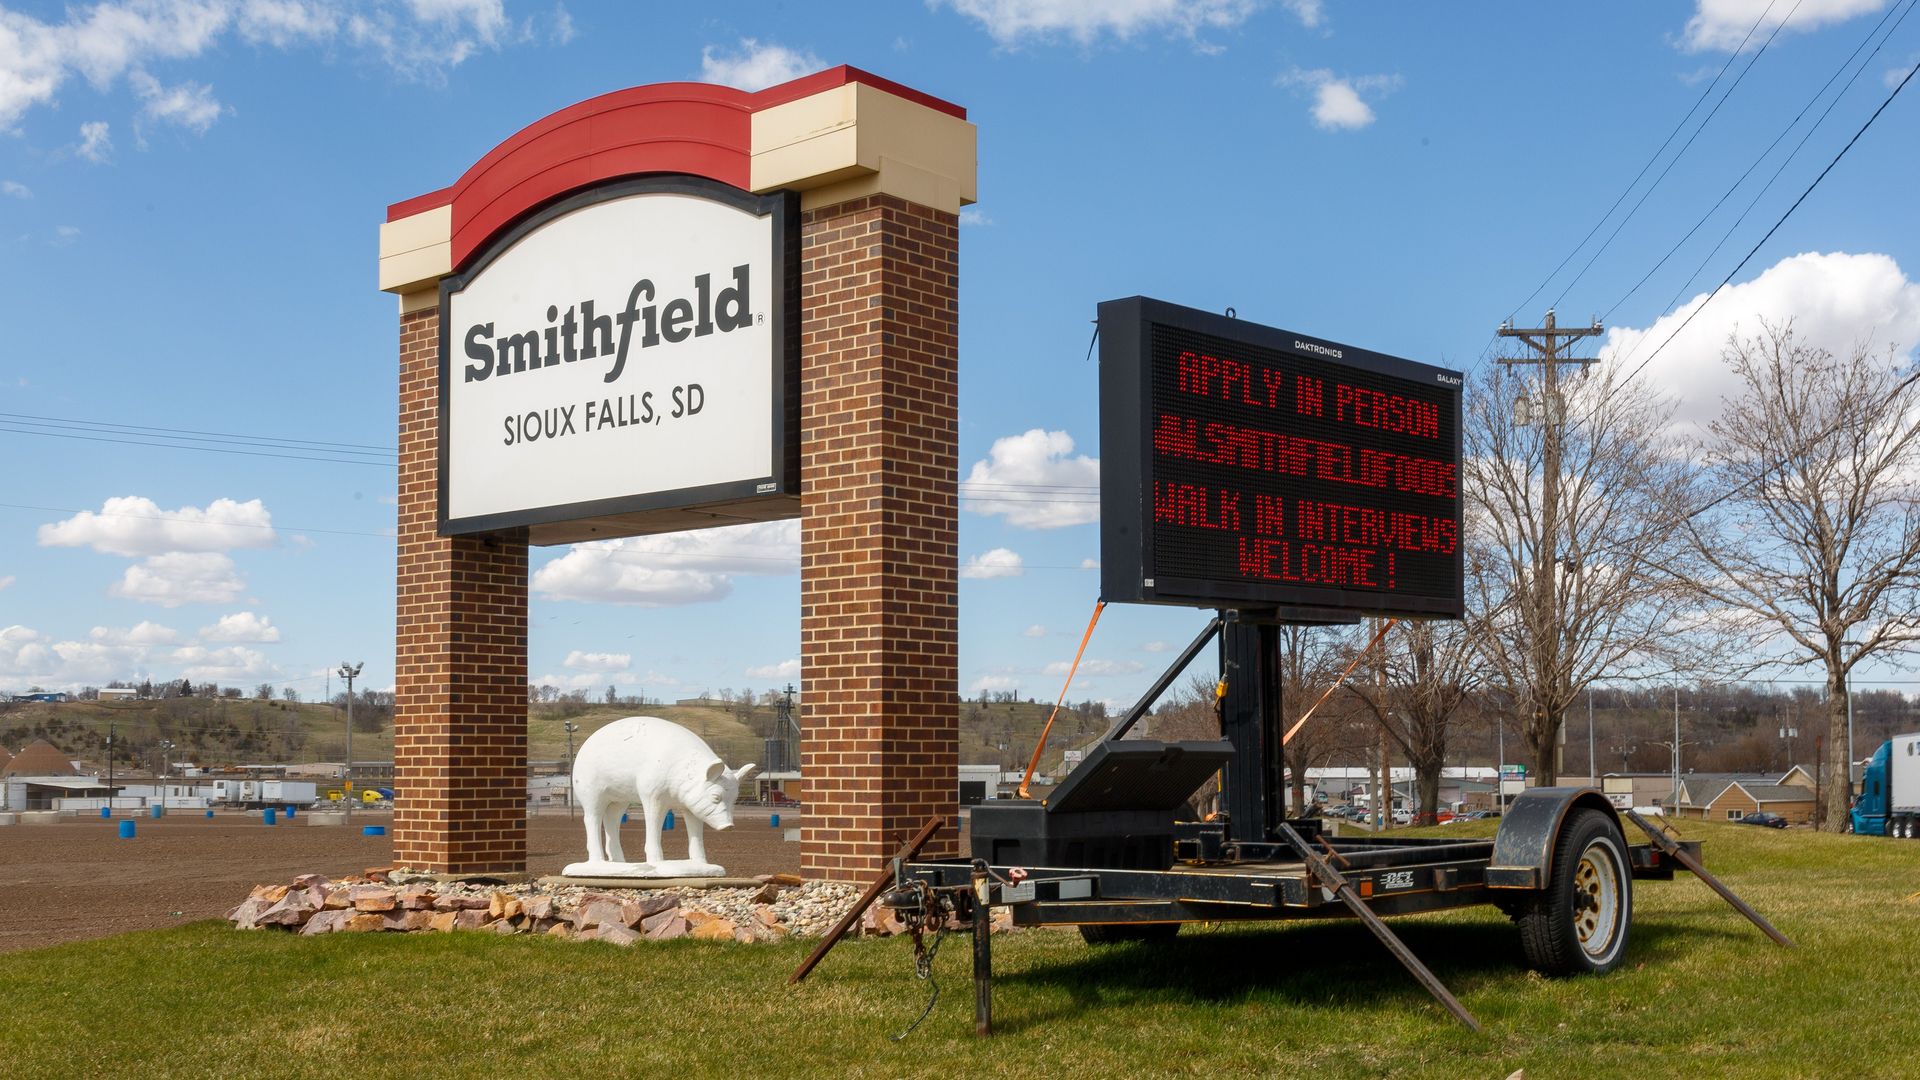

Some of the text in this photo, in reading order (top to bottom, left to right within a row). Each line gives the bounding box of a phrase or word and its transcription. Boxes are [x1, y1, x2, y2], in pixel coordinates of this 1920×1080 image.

[464, 264, 753, 384] Smithfield
[1295, 340, 1343, 359] DAKTRONICS
[1179, 351, 1438, 439] APPLY IN PERSON
[1437, 373, 1462, 386] GALAXY
[503, 383, 705, 446] SIOUX FALLS, SD
[1155, 481, 1457, 554] WALK IN INTERVIEWS
